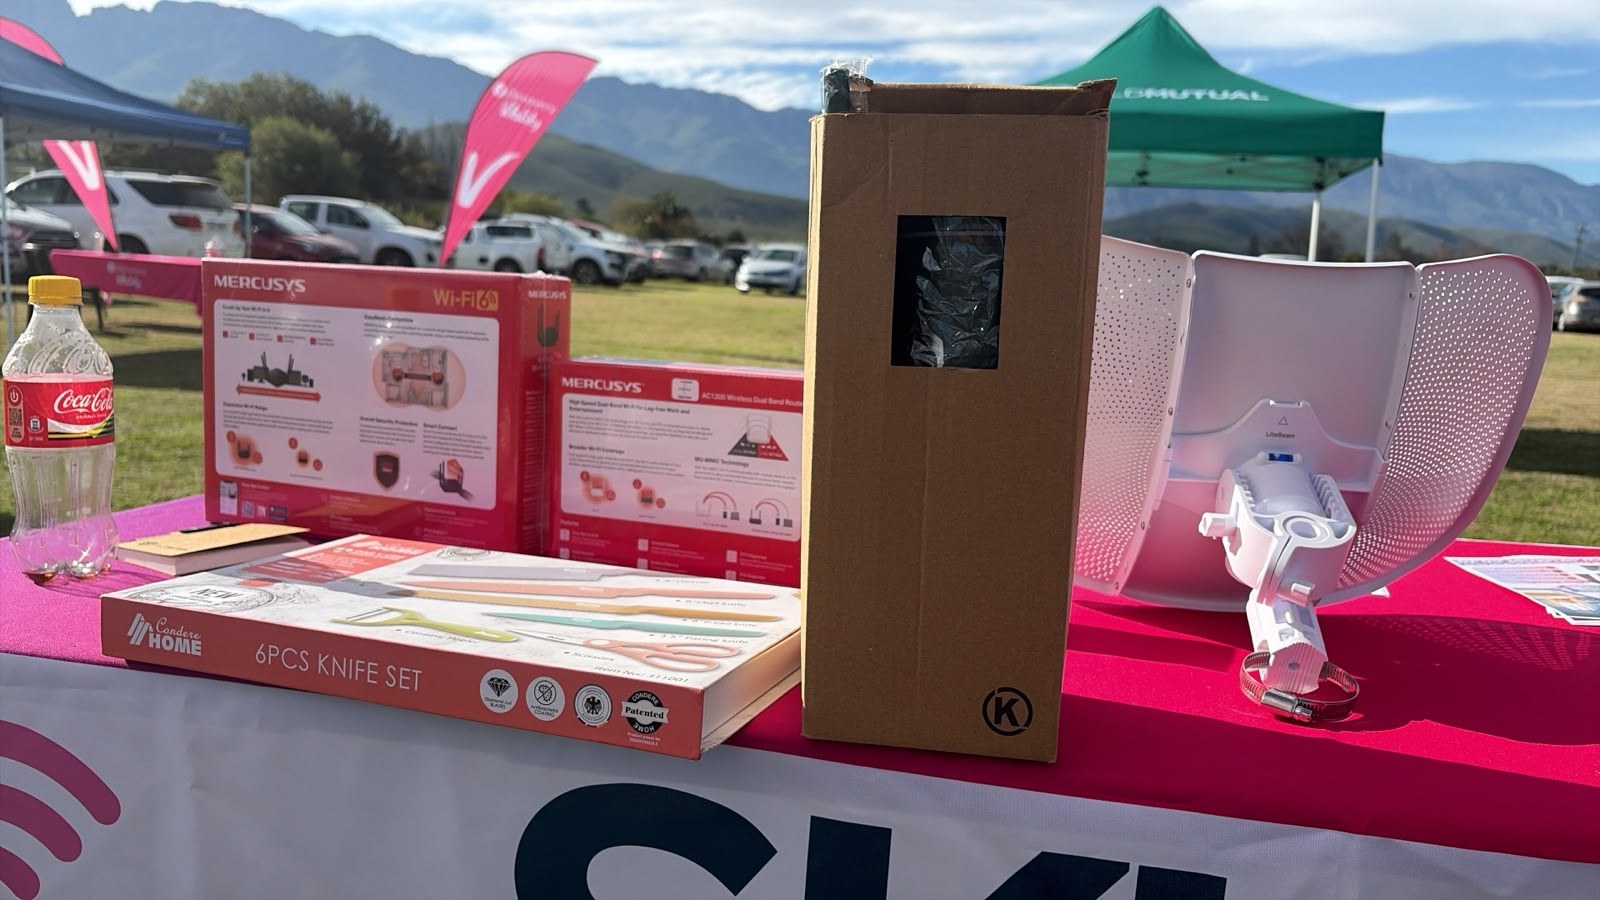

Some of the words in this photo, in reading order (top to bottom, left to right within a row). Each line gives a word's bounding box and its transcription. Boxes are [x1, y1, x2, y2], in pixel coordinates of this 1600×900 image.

[214, 275, 306, 293] MERCUSYS
[528, 290, 567, 299] MERCUSYS
[562, 377, 643, 394] MERCUSYS
[727, 394, 753, 404] Wireless
[190, 588, 244, 599] NEW
[156, 617, 202, 640] Condere
[148, 632, 202, 657] HOME
[571, 651, 615, 662] Scissors
[255, 643, 310, 672] 6PCS
[317, 653, 379, 684] KNIFE
[385, 665, 423, 691] SET
[593, 664, 621, 674] Item
[632, 691, 660, 706] CONDERE
[625, 706, 664, 720] Patented
[633, 721, 655, 733] HOME
